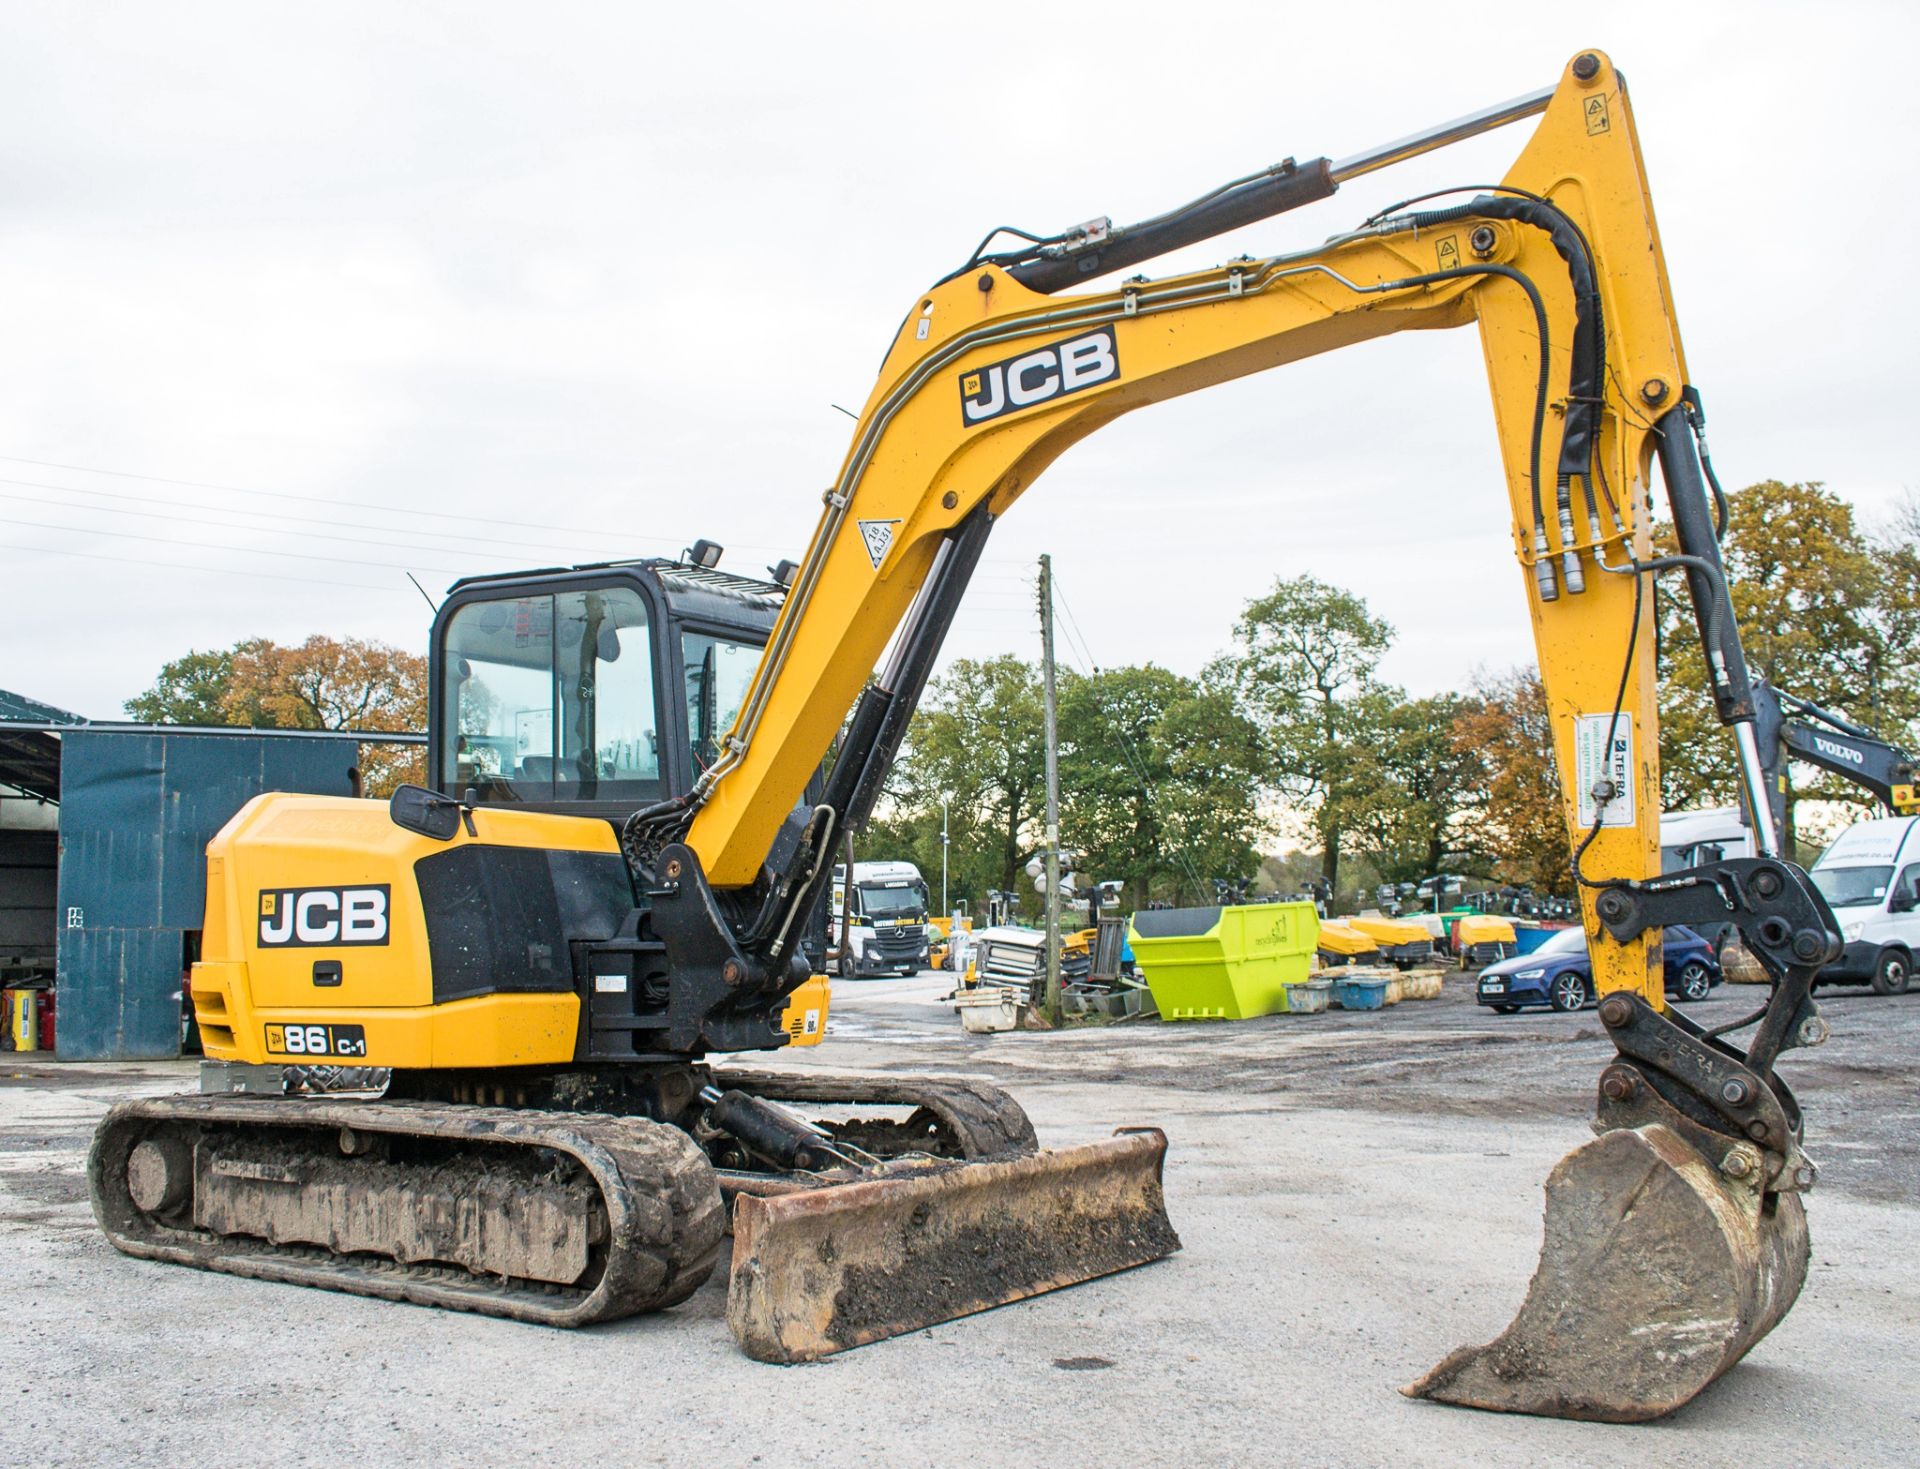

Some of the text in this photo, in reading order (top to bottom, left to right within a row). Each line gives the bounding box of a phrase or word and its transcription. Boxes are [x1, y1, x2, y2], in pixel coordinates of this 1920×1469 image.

[966, 333, 1115, 420] JCB
[1814, 736, 1864, 764] VOLVO
[261, 889, 387, 943] JCB
[284, 1025, 365, 1055] 86 C-1
